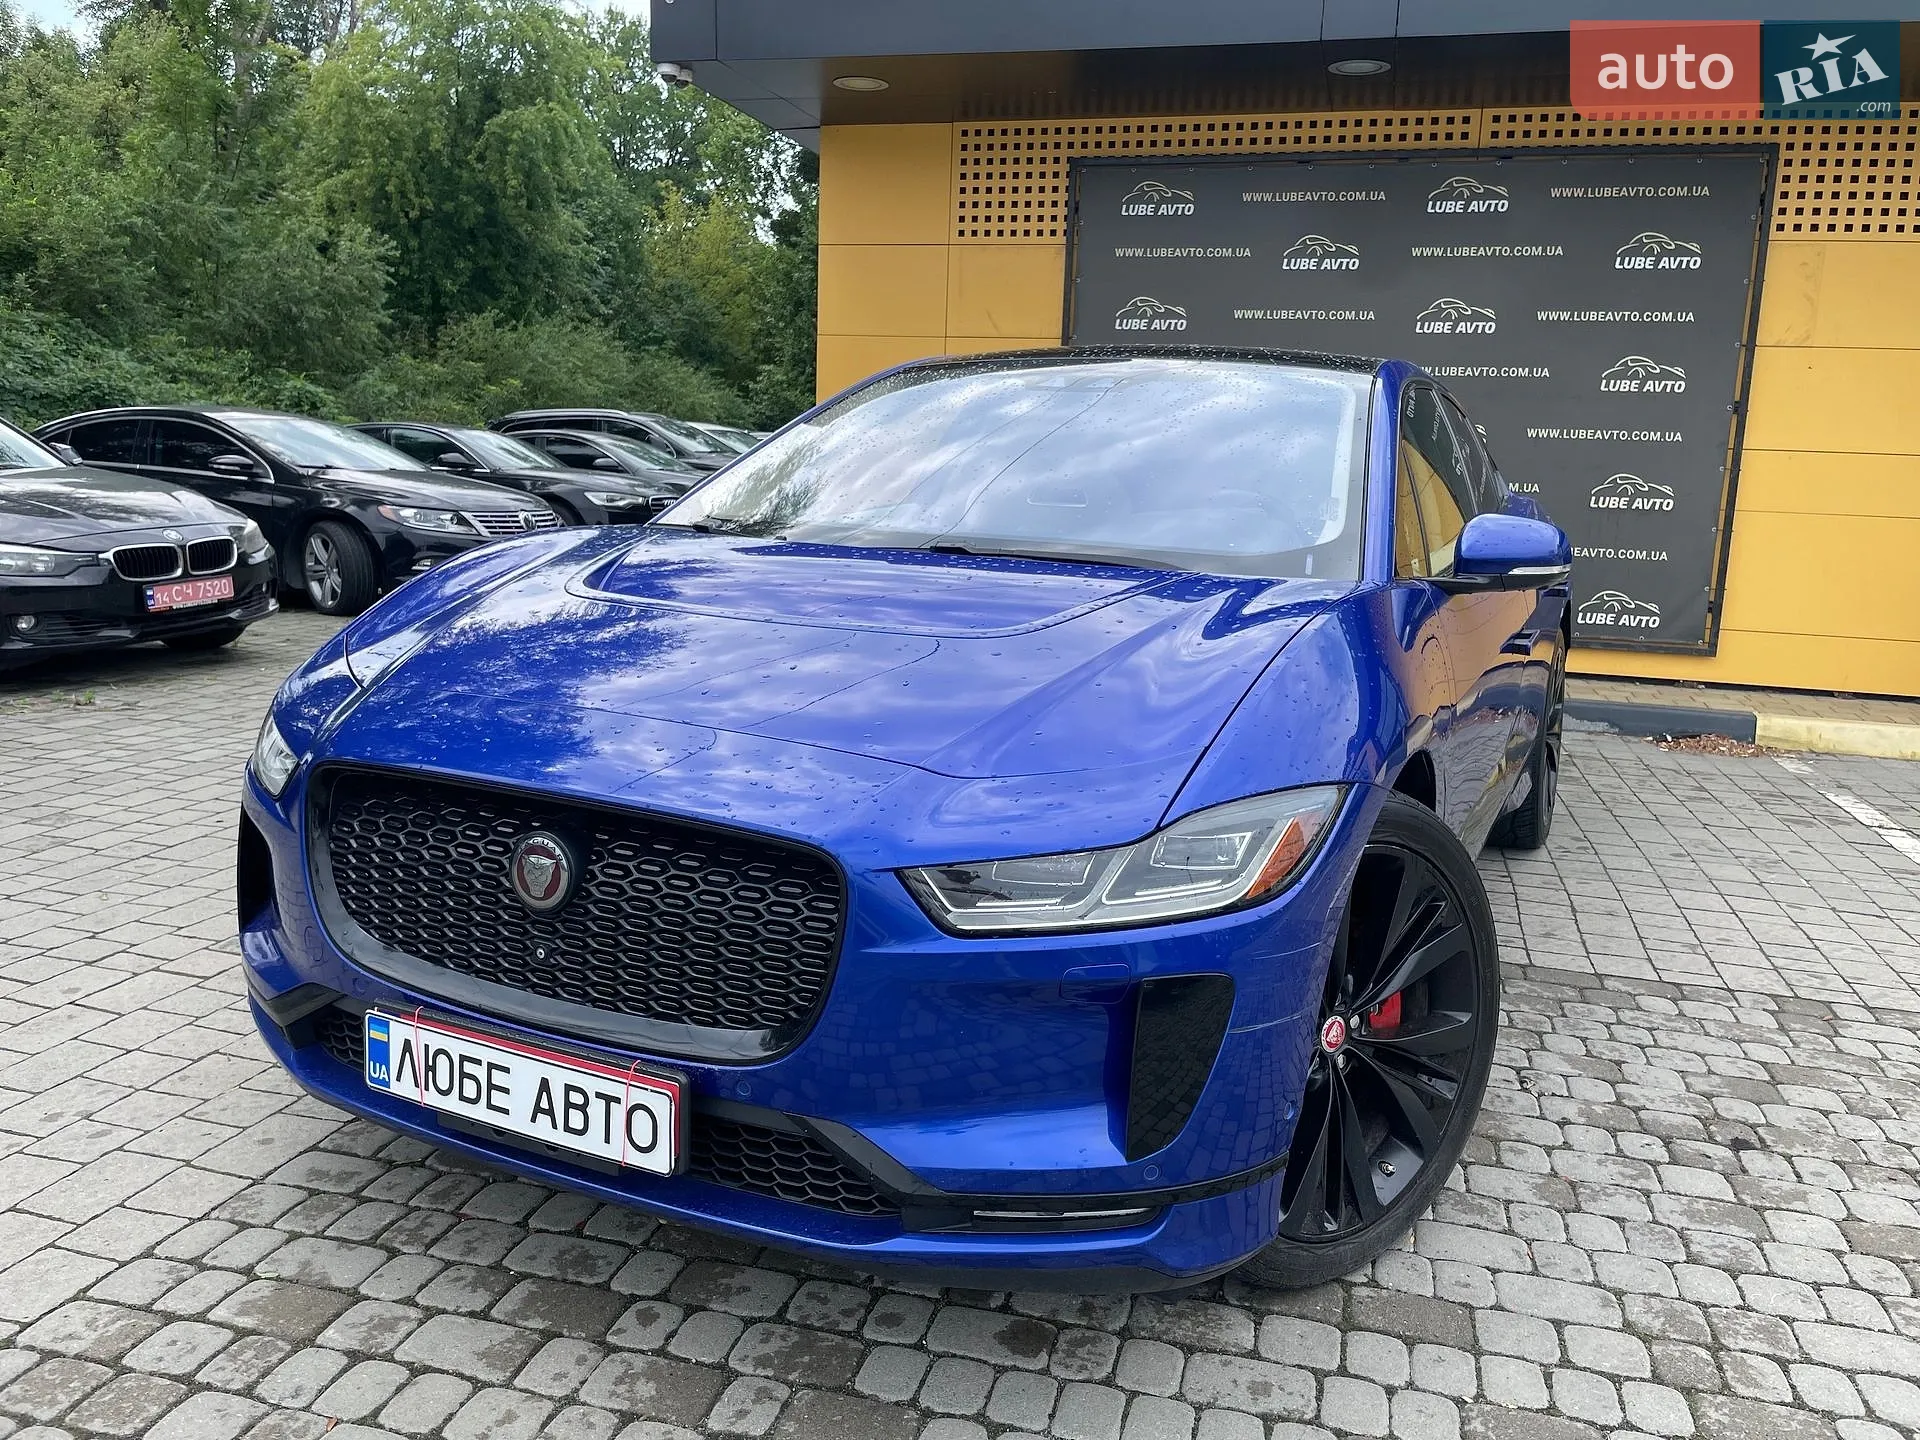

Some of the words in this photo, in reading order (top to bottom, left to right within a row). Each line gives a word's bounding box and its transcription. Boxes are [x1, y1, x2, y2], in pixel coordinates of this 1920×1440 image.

[1242, 190, 1386, 202] WWW.LUBEAVTO.COM.UA
[1550, 185, 1710, 198] WWW.LUBEAVTO.COM.UA
[1121, 203, 1157, 216] LUBE
[1158, 202, 1195, 216] AVTO
[1427, 201, 1465, 213] LUBE
[1467, 199, 1509, 213] AVTO
[1114, 247, 1251, 258] WWW.LUBEAVTO.COM.UA
[1411, 245, 1563, 257] WWW.LUBEAVTO.COM.UA
[1282, 258, 1319, 271] LUBE
[1320, 257, 1360, 271] AVTO
[1614, 256, 1655, 270] LUBE
[1657, 256, 1702, 270] AVTO
[1233, 309, 1375, 321] WWW.LUBEAVTO.COM.UA
[1536, 310, 1695, 322] WWW.LUBEAVTO.COM.UA
[1114, 318, 1149, 331] LUBE
[1150, 318, 1187, 331] AVTO
[1415, 321, 1453, 334] LUBE
[1455, 321, 1496, 334] AVTO
[1600, 379, 1640, 392] LUBE
[1642, 380, 1686, 393] AVTO
[1526, 427, 1683, 442] WWW.LUBEAVTO.COM.UA
[1590, 496, 1629, 509] LUBE
[1631, 497, 1674, 511] AVTO
[1571, 547, 1668, 561] EAVTO.COM.UA
[156, 592, 170, 604] 14
[196, 579, 229, 598] 7520
[1576, 612, 1616, 625] LUBE
[1618, 613, 1661, 628] AVTO
[370, 1062, 389, 1083] UA
[396, 1038, 511, 1116] ЛЮБЕ
[530, 1077, 658, 1154] АВТО
